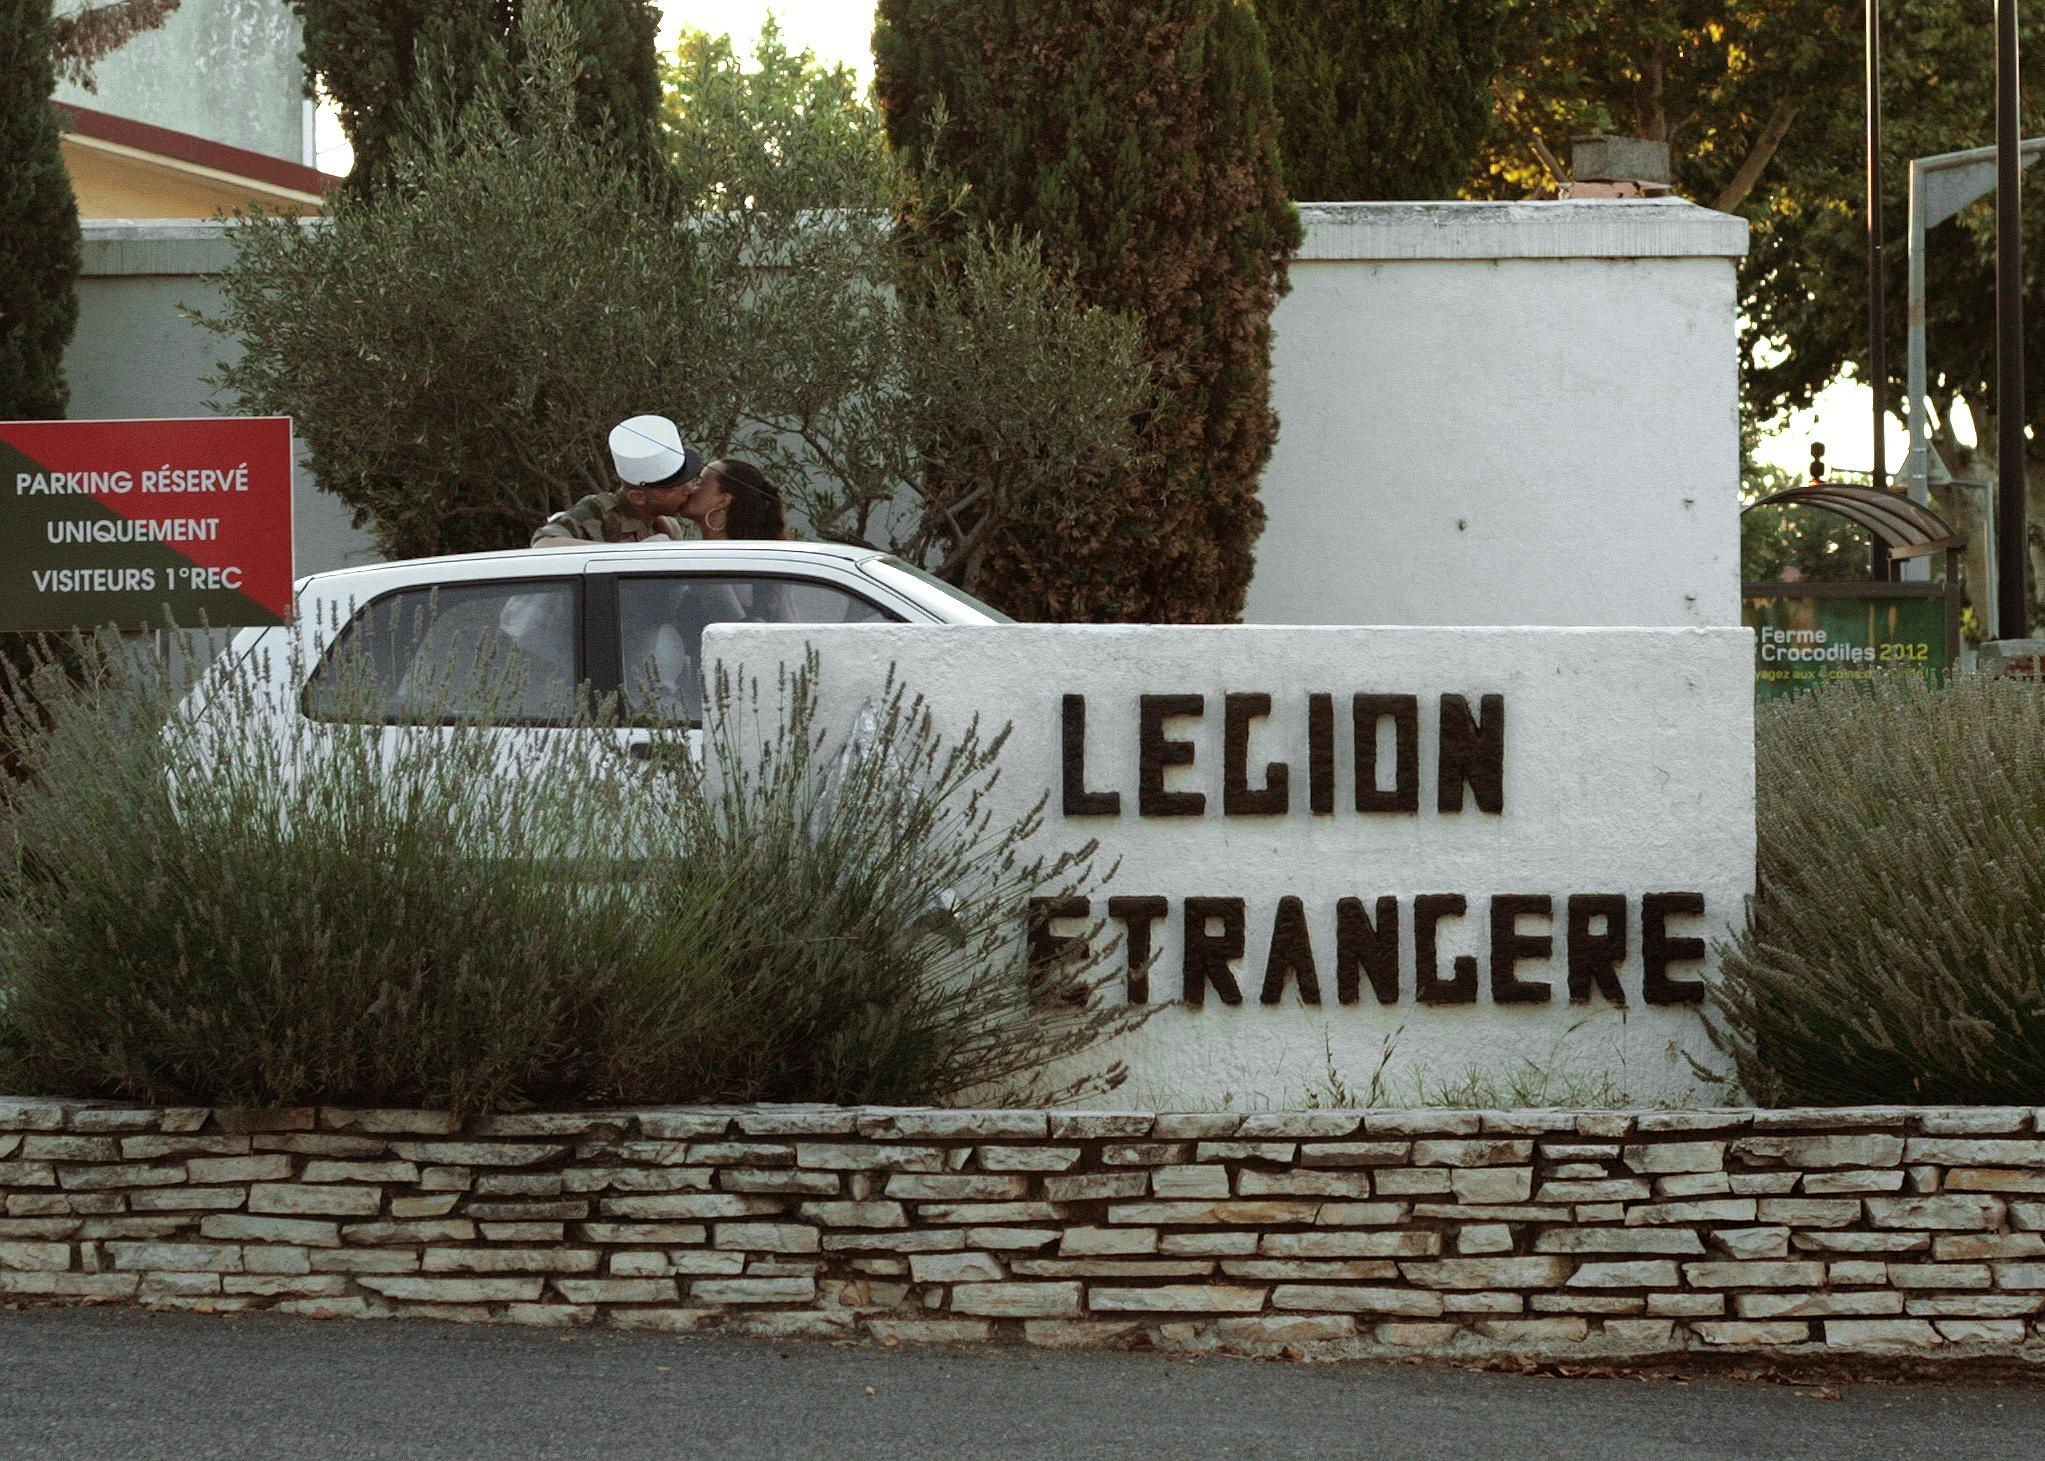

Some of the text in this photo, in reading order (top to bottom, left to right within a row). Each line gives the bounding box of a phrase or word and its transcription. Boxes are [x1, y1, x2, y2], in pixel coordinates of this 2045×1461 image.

[16, 463, 249, 495] PARKING RÉSERVÉ
[47, 518, 220, 544] UNIQUEMENT
[32, 566, 243, 592] VISITEURS 1°REC
[1761, 626, 1827, 644] Ferme
[1761, 643, 1930, 662] Crocodiles 2012
[1061, 693, 1505, 817] LEGION
[1027, 892, 1706, 1007] ETRANGERE
